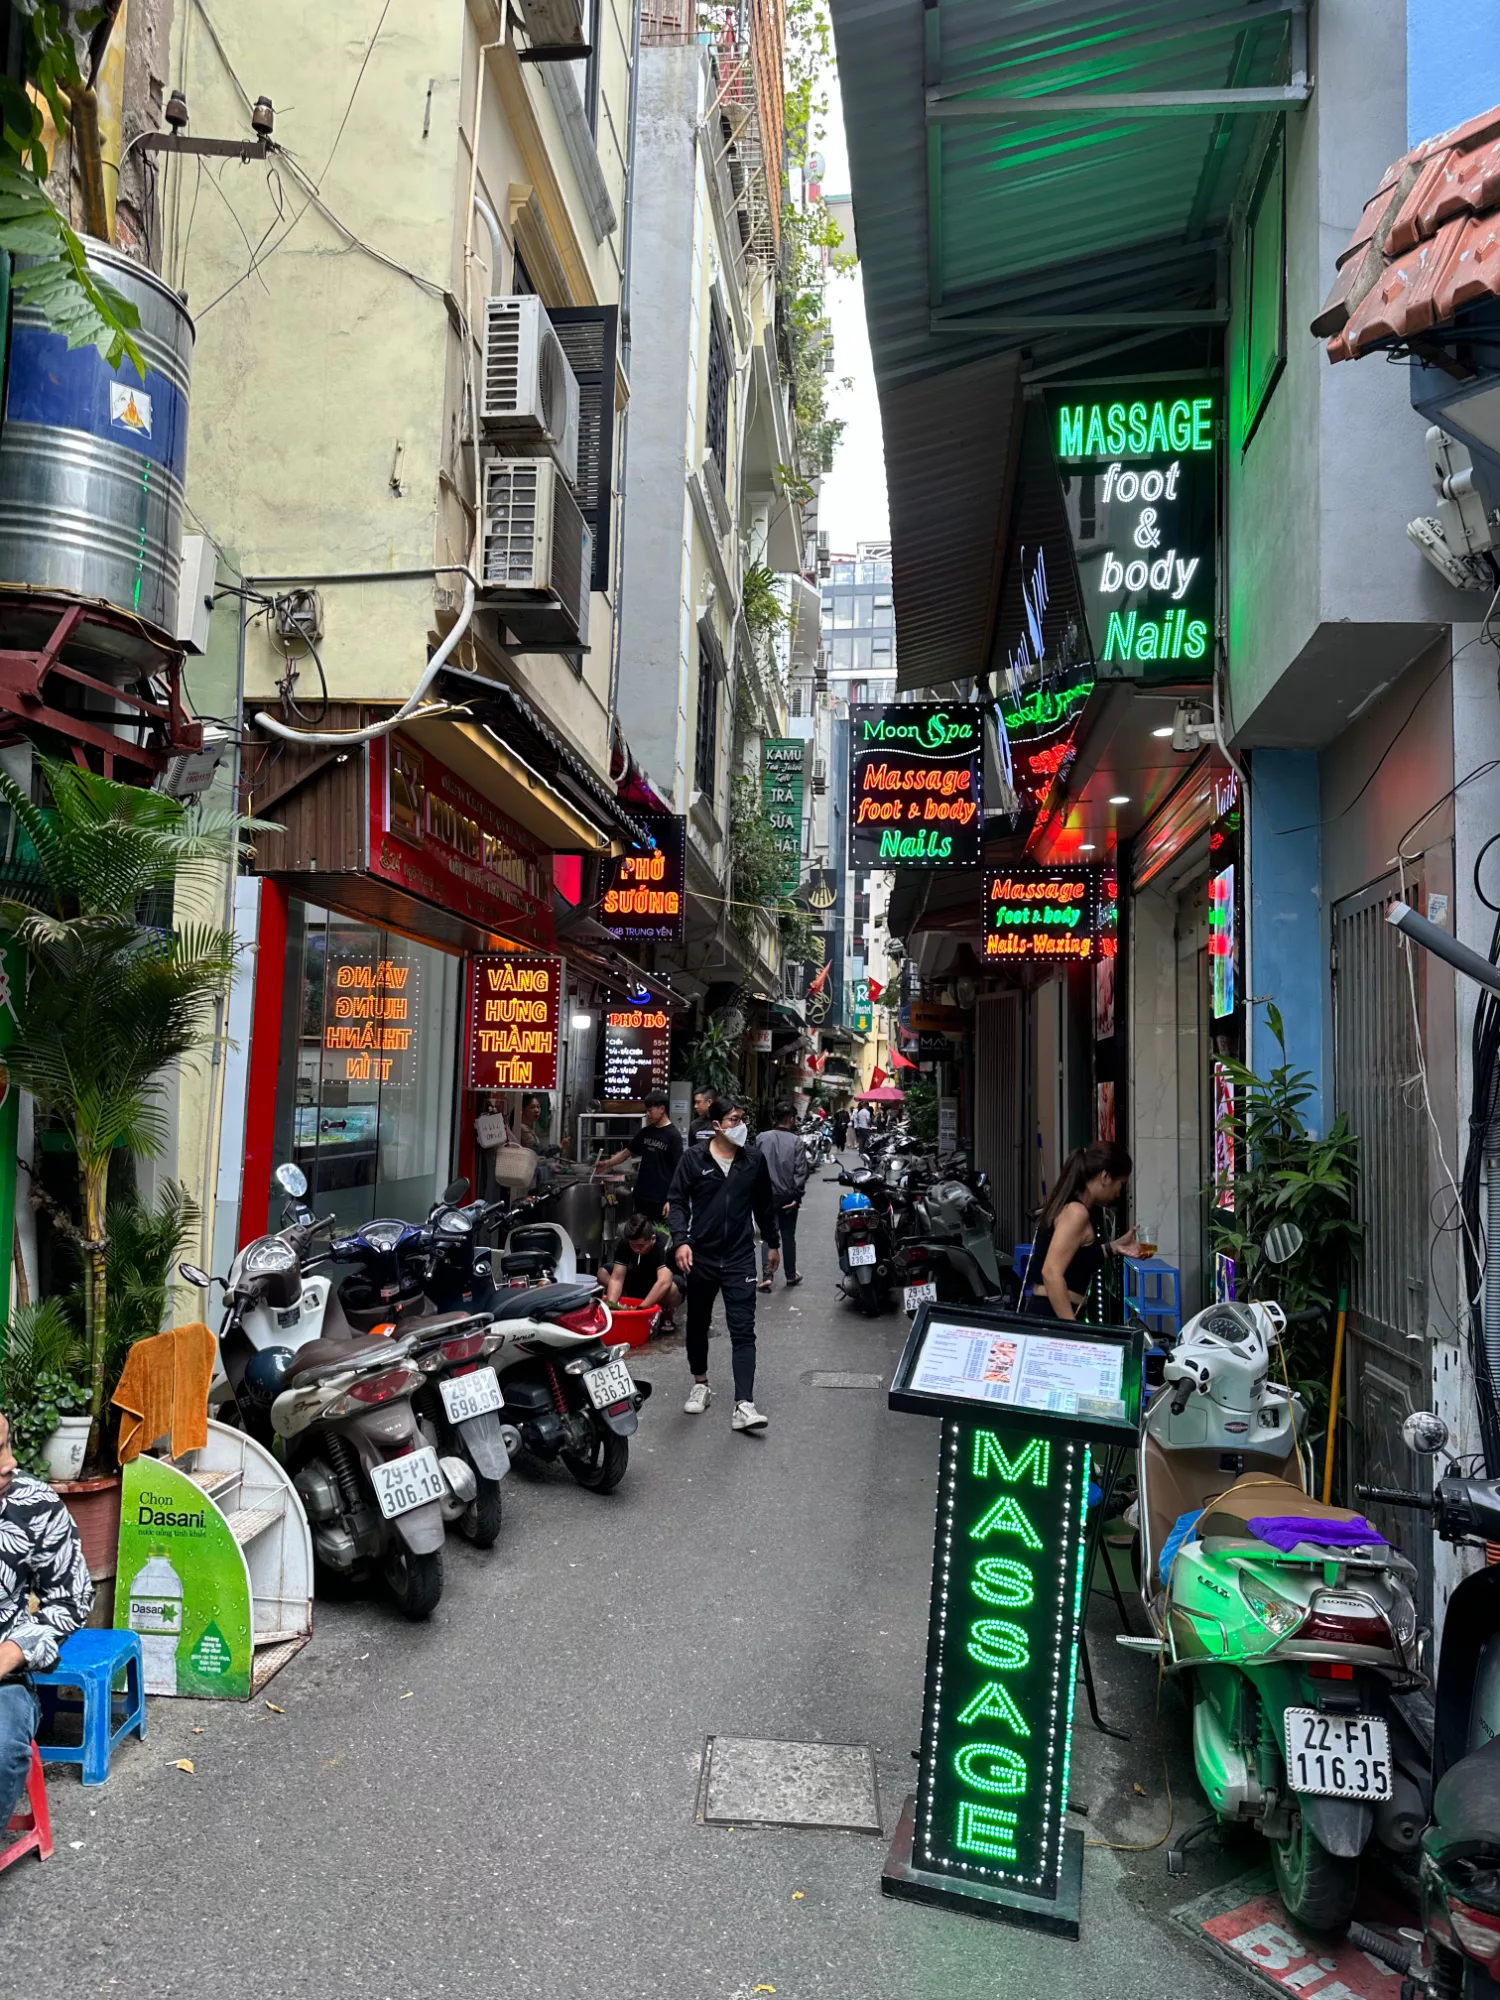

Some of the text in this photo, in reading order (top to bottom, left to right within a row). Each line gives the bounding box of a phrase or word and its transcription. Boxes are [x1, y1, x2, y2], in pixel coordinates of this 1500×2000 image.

[1059, 399, 1213, 457] MASSAGE
[1101, 459, 1182, 504] foot
[1133, 506, 1161, 549] &
[1099, 548, 1200, 600] body
[1102, 608, 1208, 662] Nails
[863, 713, 973, 748] Moon Spa
[766, 748, 802, 761] KAMU
[771, 783, 795, 803] TRÀ
[863, 763, 971, 796] Massage
[856, 797, 977, 825] foot & body
[879, 829, 953, 858] Nails
[620, 849, 666, 881] PHỞ
[604, 885, 679, 915] SƯỚNG
[990, 879, 1085, 903] Massage
[625, 926, 654, 937] TRUNG
[655, 925, 673, 937] YÊN
[996, 905, 1081, 928] foot & body
[986, 932, 1092, 957] Nails-Waxing
[487, 963, 549, 992] VÀNG
[485, 997, 548, 1023] HƯNG
[609, 1009, 642, 1028] PHỞ
[854, 1005, 871, 1016] Hostel
[478, 1024, 553, 1054] THÀNH
[496, 1055, 533, 1084] TÍN
[590, 1364, 625, 1388] 29-E2
[449, 1389, 500, 1419] 698.96
[593, 1377, 632, 1405] 536.37
[139, 1491, 174, 1509] Chọn
[383, 1473, 442, 1513] 306.18
[138, 1507, 205, 1528] Dasani
[131, 1603, 166, 1614] Dasani
[1322, 1599, 1366, 1609] HONDA
[953, 1429, 1051, 1860] MASSAGE
[1297, 1752, 1389, 1795] 116.35
